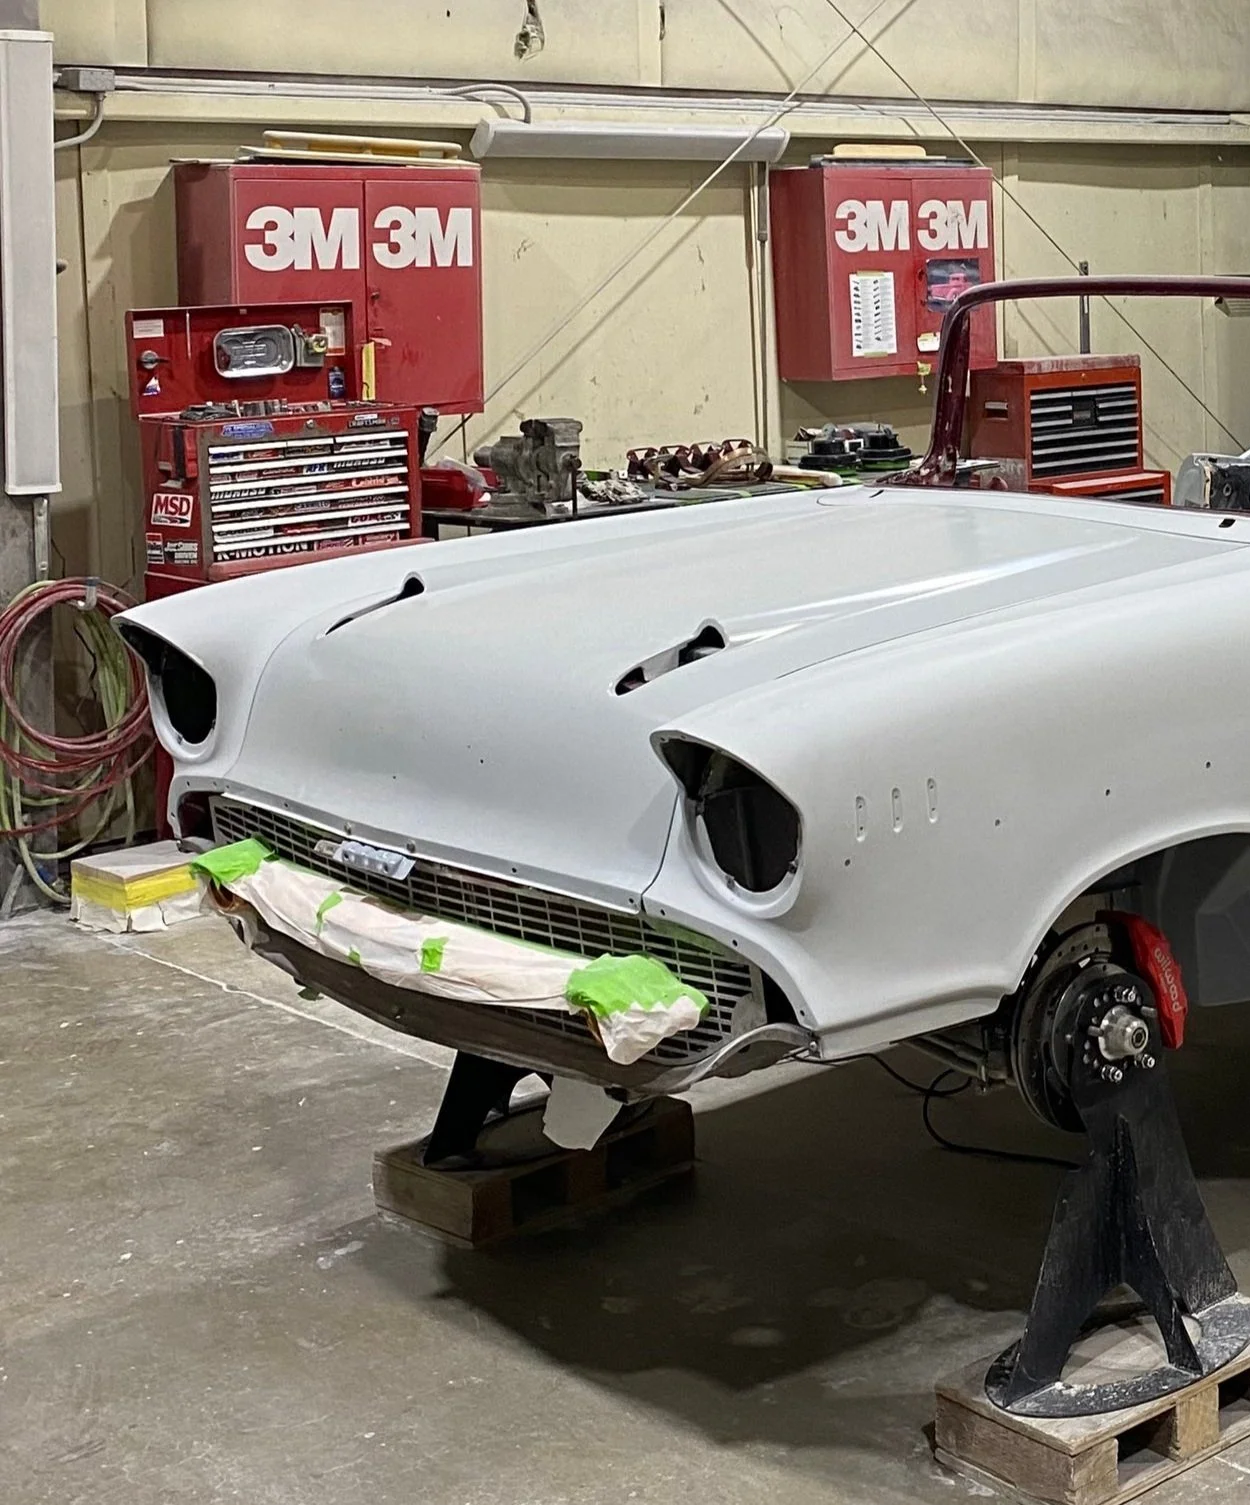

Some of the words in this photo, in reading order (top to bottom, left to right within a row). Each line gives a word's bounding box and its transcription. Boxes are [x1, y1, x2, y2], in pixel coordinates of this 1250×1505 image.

[244, 205, 360, 272] 3M
[372, 205, 473, 269] 3M
[834, 199, 910, 253] 3M
[917, 199, 989, 251] 3M
[155, 495, 190, 516] MSD
